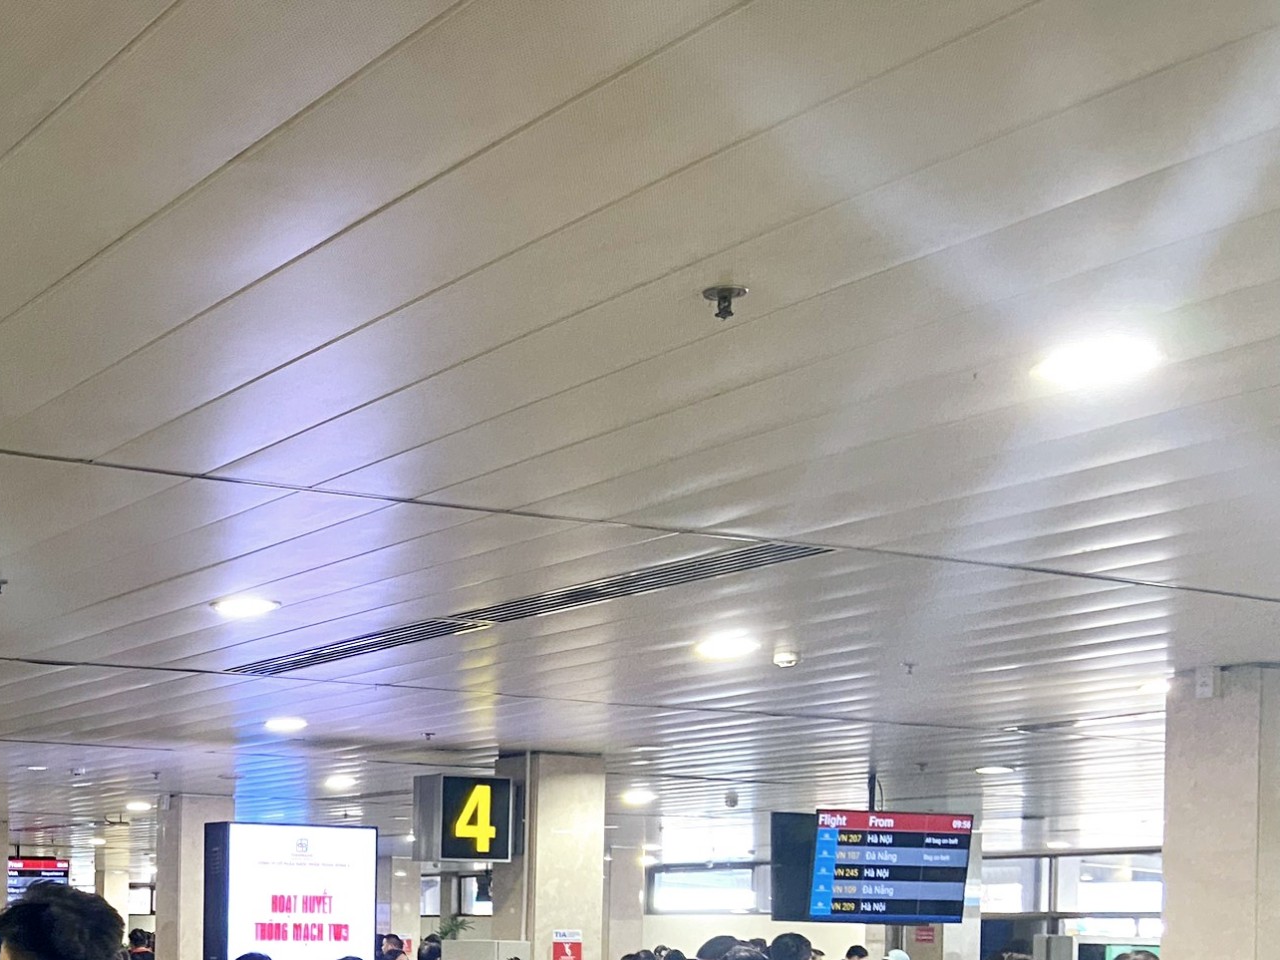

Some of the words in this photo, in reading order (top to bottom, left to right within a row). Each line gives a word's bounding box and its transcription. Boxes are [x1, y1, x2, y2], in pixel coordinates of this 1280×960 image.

[455, 784, 497, 854] 4
[818, 813, 847, 828] Flight
[869, 815, 894, 828] From
[837, 833, 848, 843] VN
[867, 833, 879, 844] Hà
[879, 833, 893, 845] Nội
[833, 867, 845, 877] VN
[845, 867, 859, 877] 245
[863, 867, 875, 878] Hà
[875, 867, 890, 879] Nội
[831, 901, 841, 911] VN
[860, 901, 872, 912] Hà
[872, 901, 886, 913] Nội
